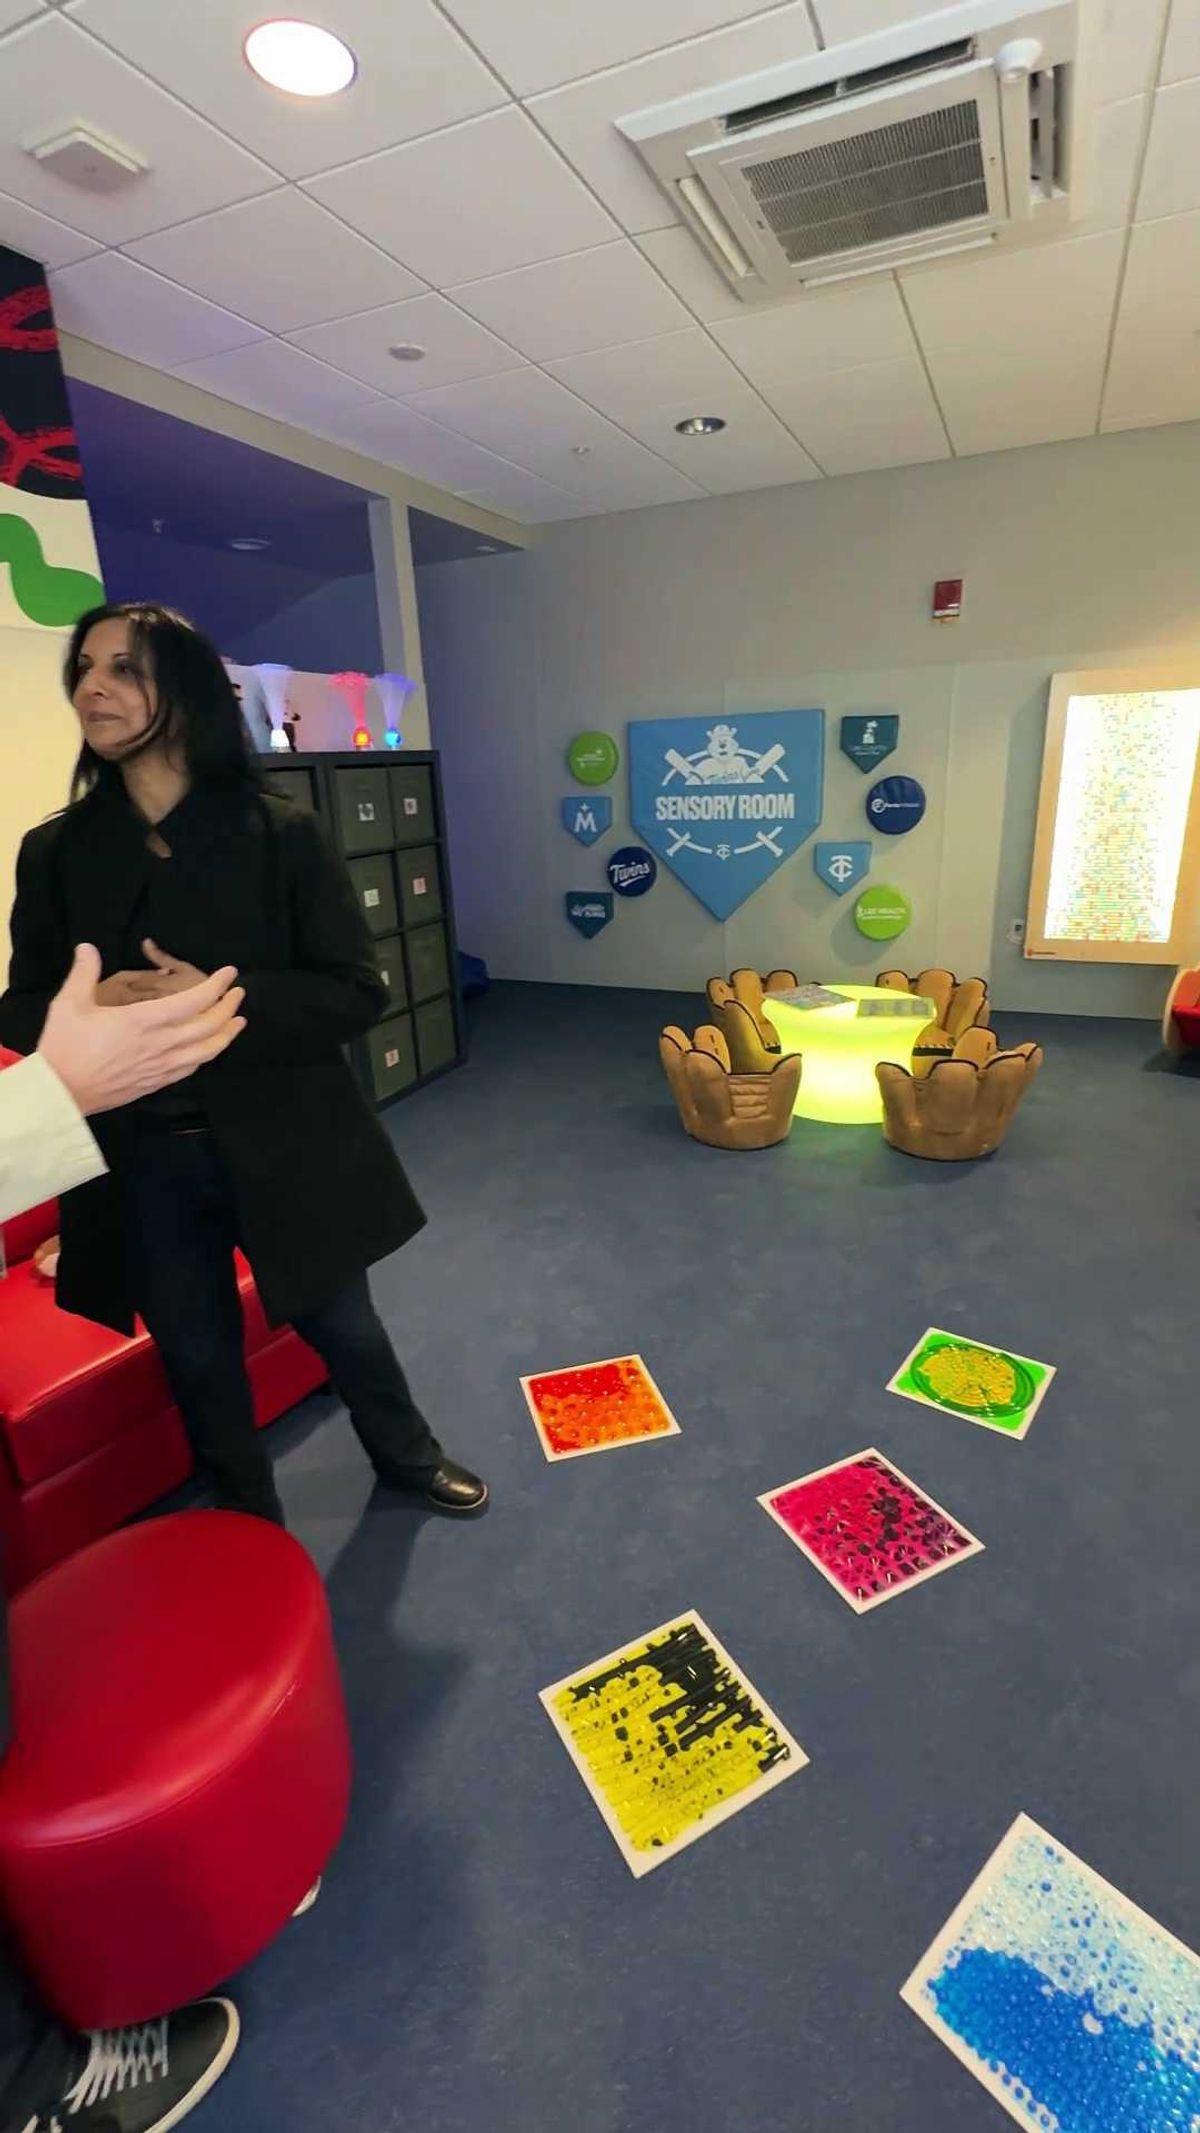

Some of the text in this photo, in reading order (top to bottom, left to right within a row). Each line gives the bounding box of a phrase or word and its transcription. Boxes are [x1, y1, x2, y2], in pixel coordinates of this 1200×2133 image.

[655, 794, 795, 821] SENSORY ROOM
[574, 812, 599, 833] M
[610, 861, 650, 885] Twins
